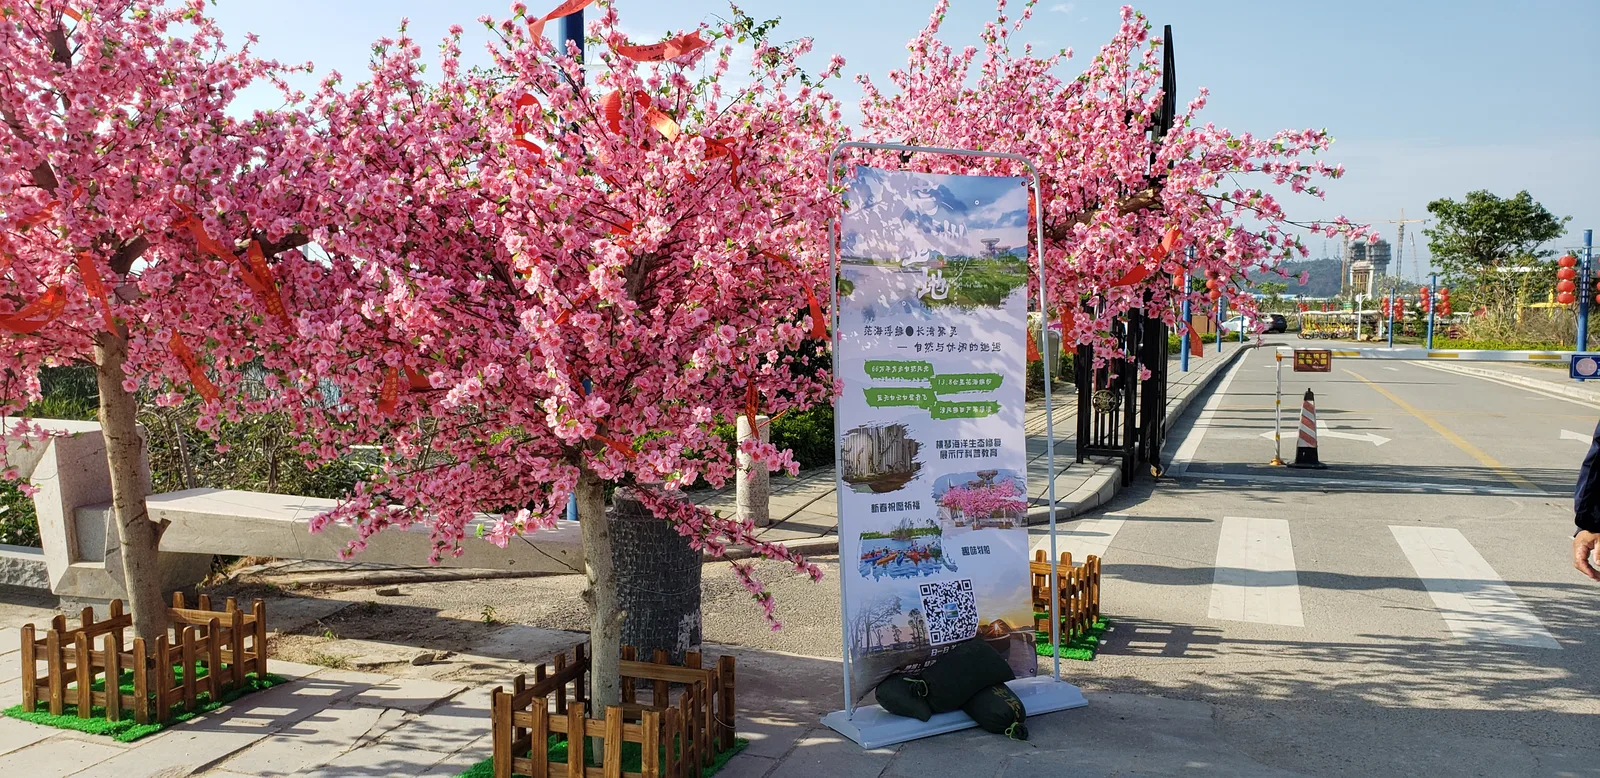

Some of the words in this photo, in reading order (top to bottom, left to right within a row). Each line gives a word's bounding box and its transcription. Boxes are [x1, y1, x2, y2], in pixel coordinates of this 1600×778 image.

[936, 438, 1002, 449] 横琴海洋生态修复
[940, 448, 998, 459] 展示厅科普教育
[871, 500, 921, 513] 新春祝愿祈福
[961, 545, 991, 556] 趣味划船
